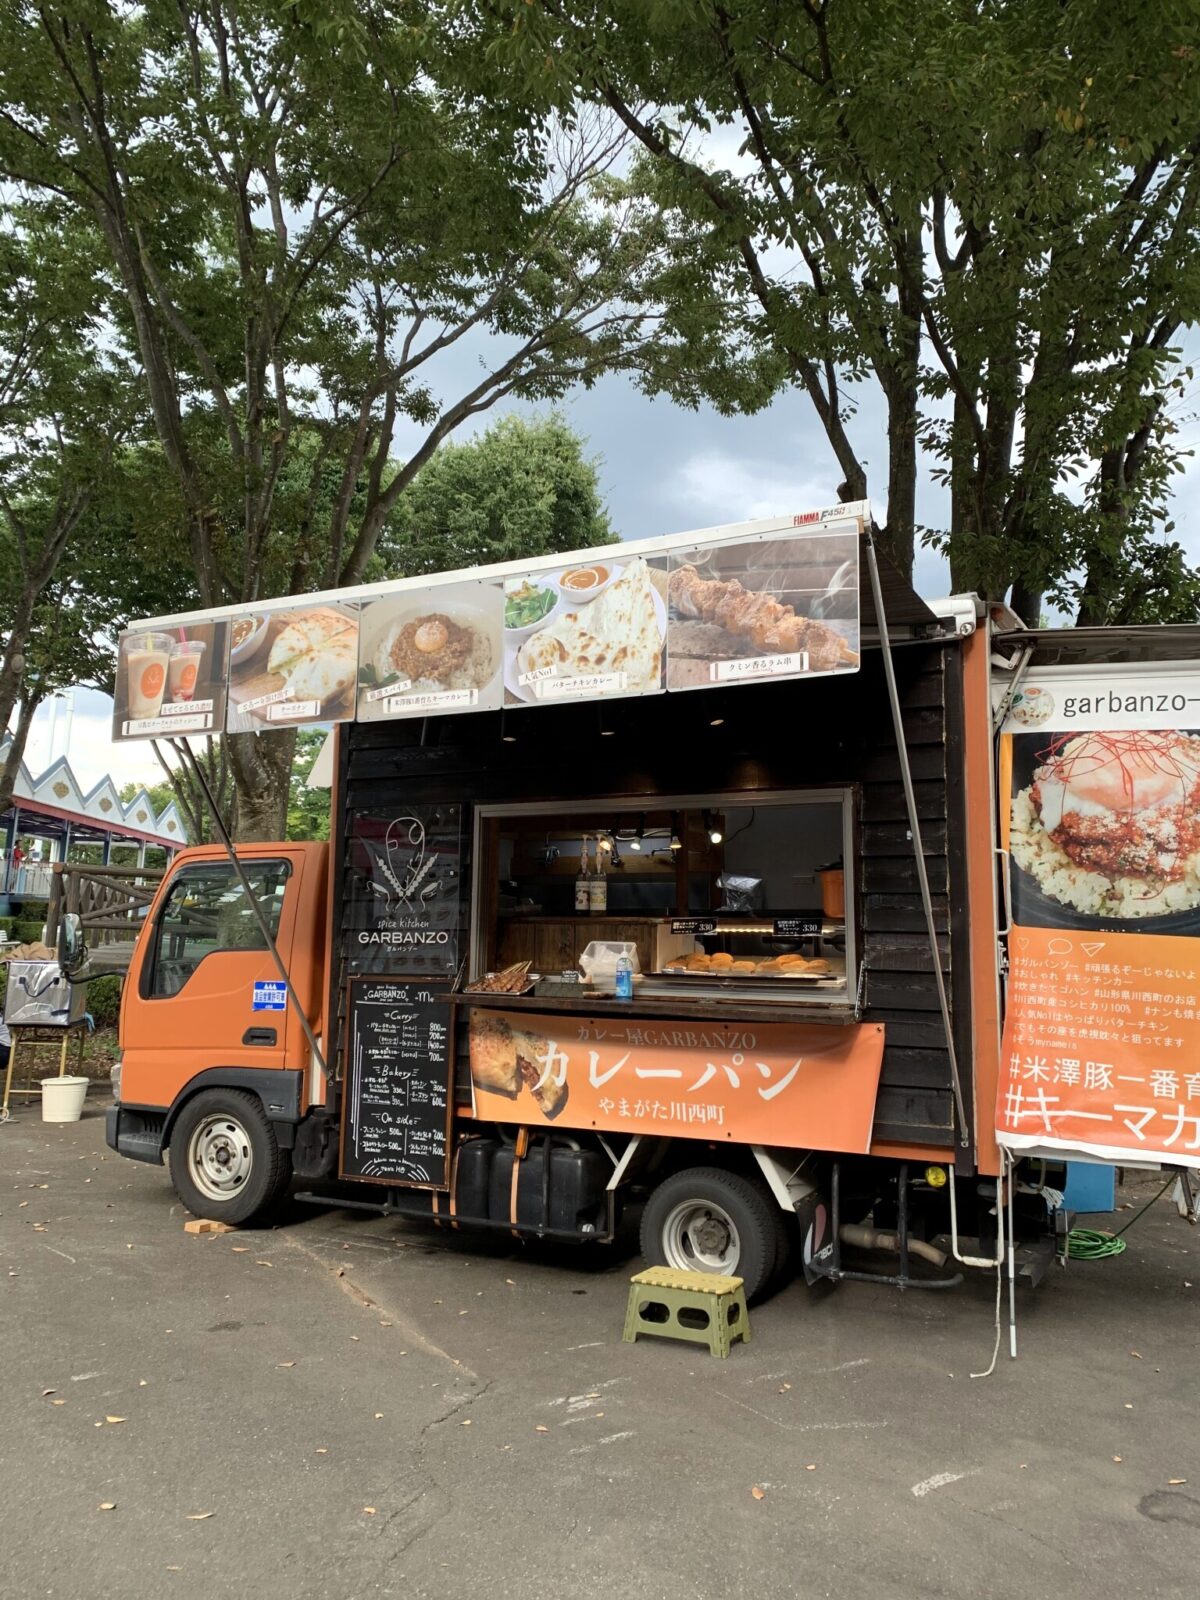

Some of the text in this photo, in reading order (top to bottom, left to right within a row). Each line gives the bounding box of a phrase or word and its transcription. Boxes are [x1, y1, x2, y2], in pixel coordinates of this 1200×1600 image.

[794, 511, 820, 526] FIAMMA
[729, 656, 792, 671] クミン香るラム串
[552, 677, 613, 688] バターチキンカレー
[377, 917, 429, 930] spice kitchen
[358, 931, 449, 944] GARBANZO
[1015, 957, 1196, 981] #ガルバンゾー #頑張るぞーじゃないよ
[1015, 968, 1134, 987] #おしゃれ #キッチンカー
[367, 990, 407, 999] GARBANZO
[1015, 981, 1196, 1007] #炊きたてゴハン #山形県川西町のお店
[390, 1010, 414, 1024] Curry
[577, 1025, 757, 1050] カレー屋GARBANZO
[381, 1064, 412, 1080] Bakery
[531, 1040, 803, 1101] カレーパン
[1010, 1052, 1200, 1100] #米澤豚一番育
[381, 1112, 413, 1126] On side
[599, 1097, 725, 1125] やまがた川西町
[1005, 1084, 1200, 1149] #キーマカ
